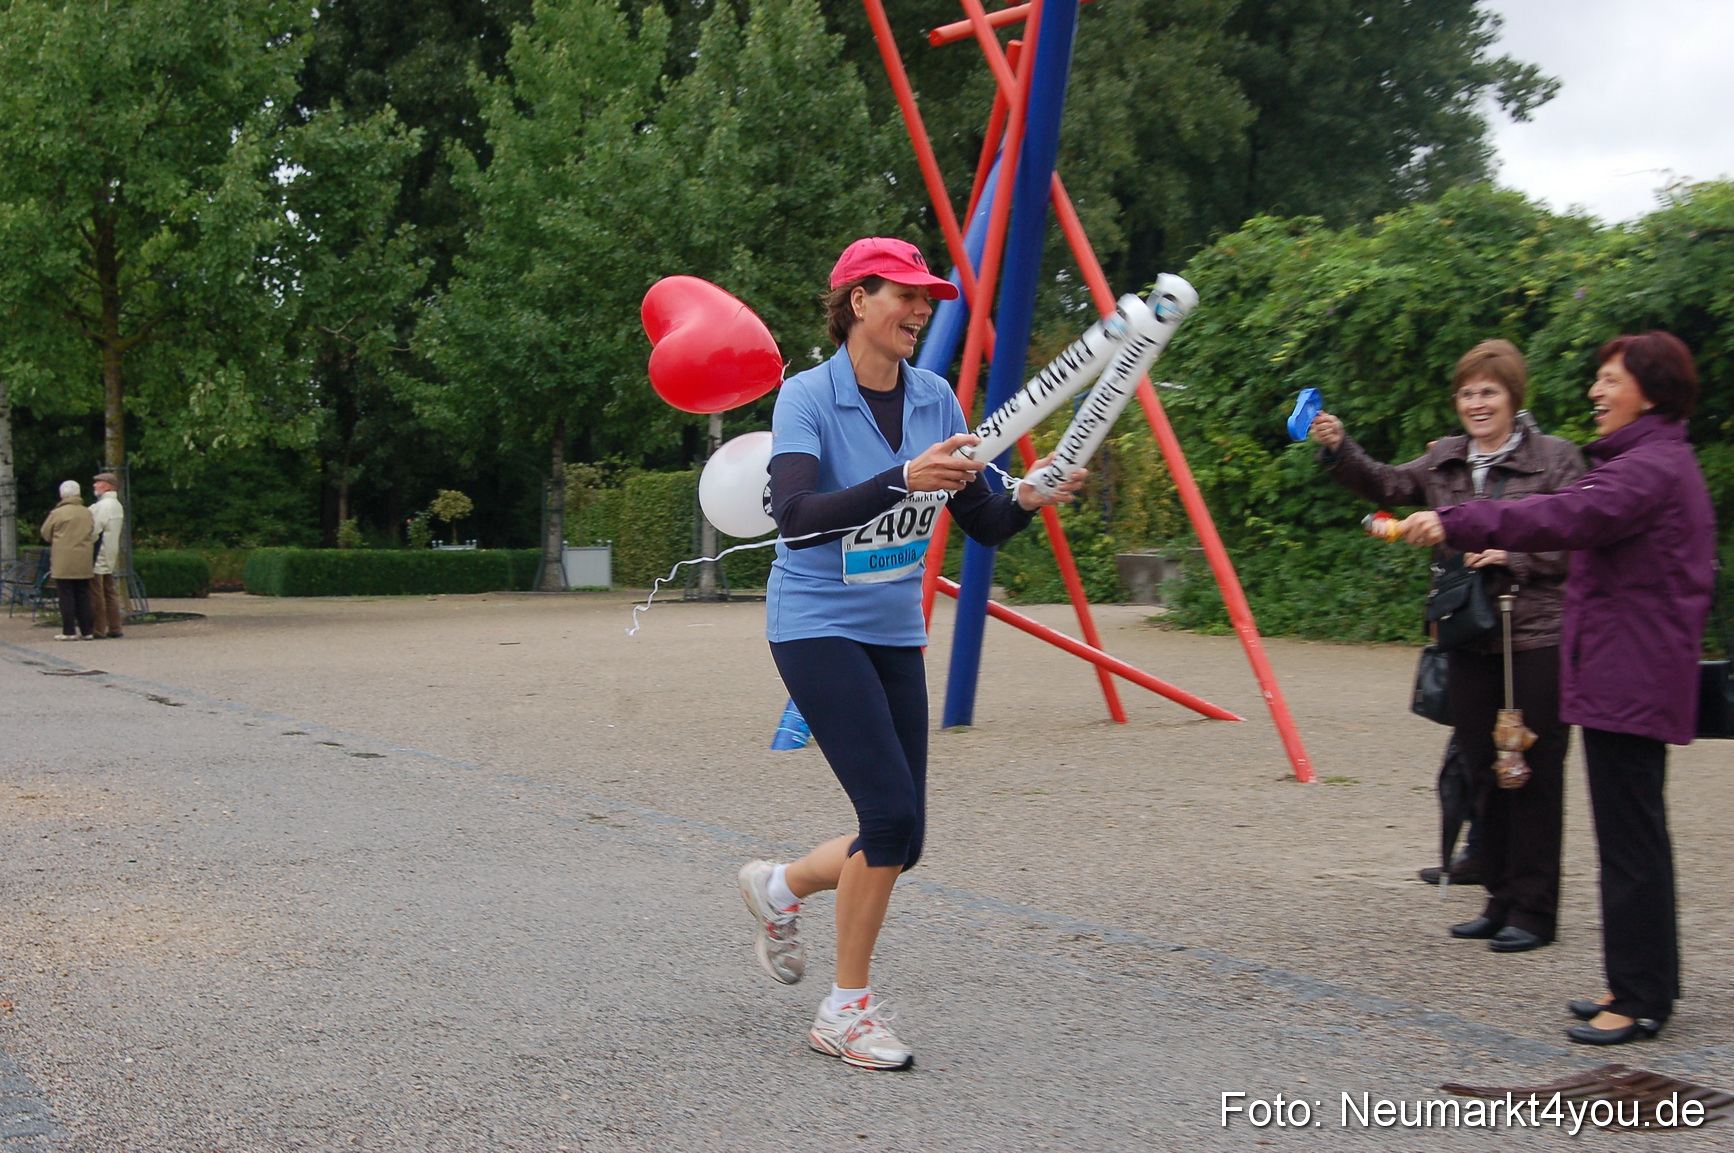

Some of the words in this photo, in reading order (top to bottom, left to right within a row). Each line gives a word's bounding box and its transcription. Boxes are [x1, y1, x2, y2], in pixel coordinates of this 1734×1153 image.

[1039, 339, 1095, 398] BMW
[854, 505, 936, 545] 2409
[869, 548, 917, 569] Cornelia
